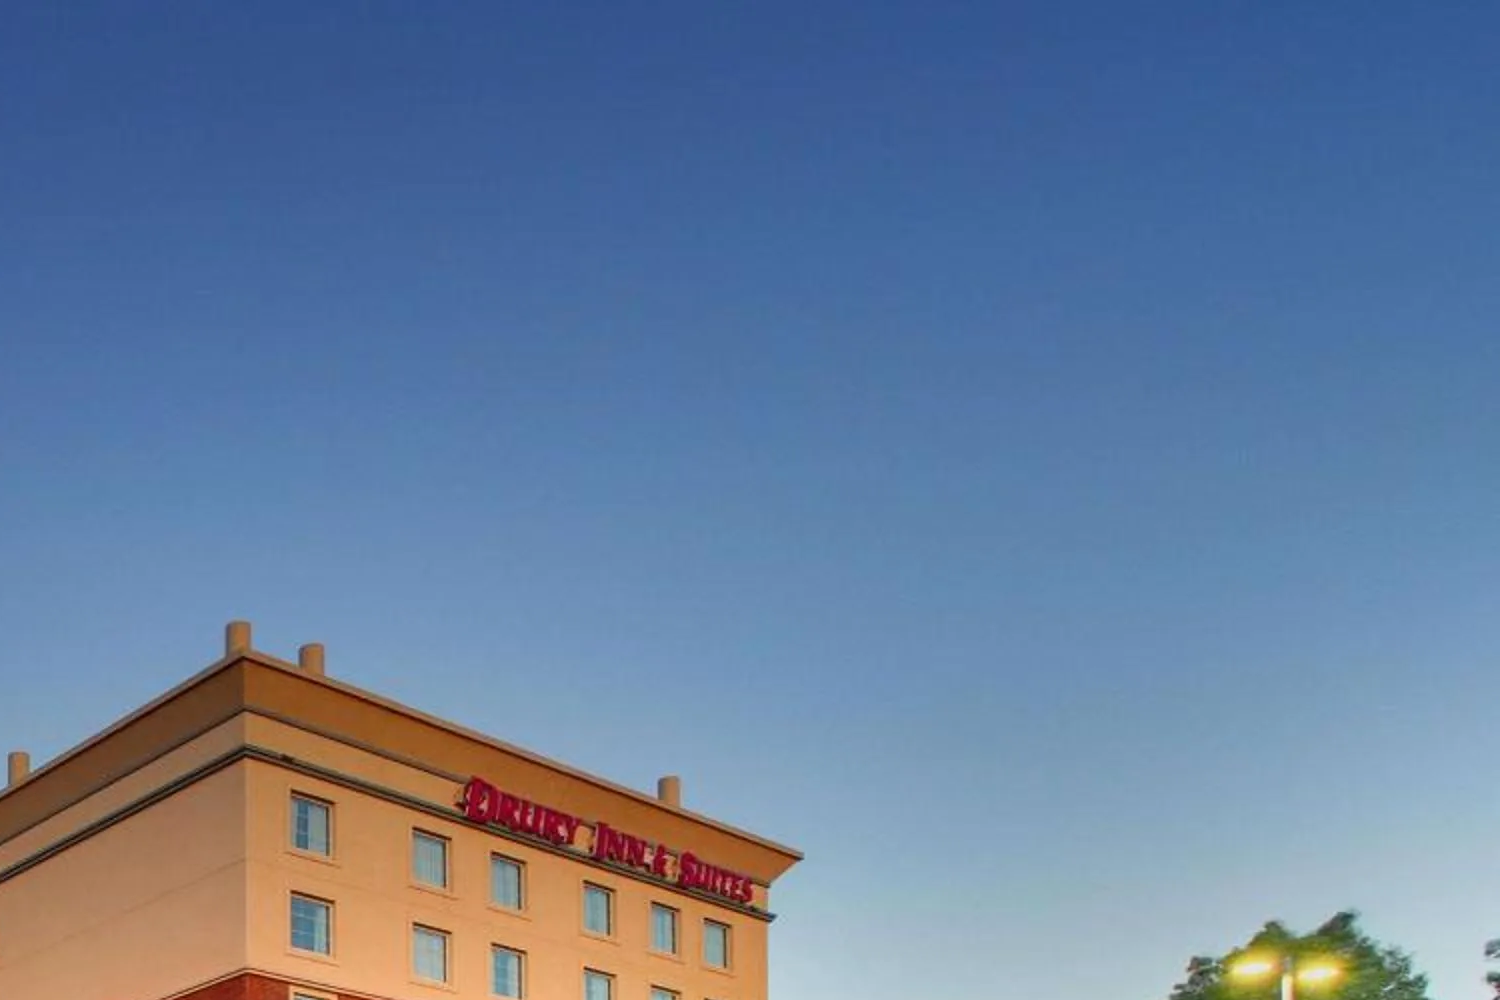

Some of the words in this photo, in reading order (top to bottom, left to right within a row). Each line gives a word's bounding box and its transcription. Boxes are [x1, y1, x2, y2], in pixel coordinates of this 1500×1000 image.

[464, 776, 580, 845] DRURY
[594, 822, 646, 867] INN
[679, 852, 753, 903] SUITES
